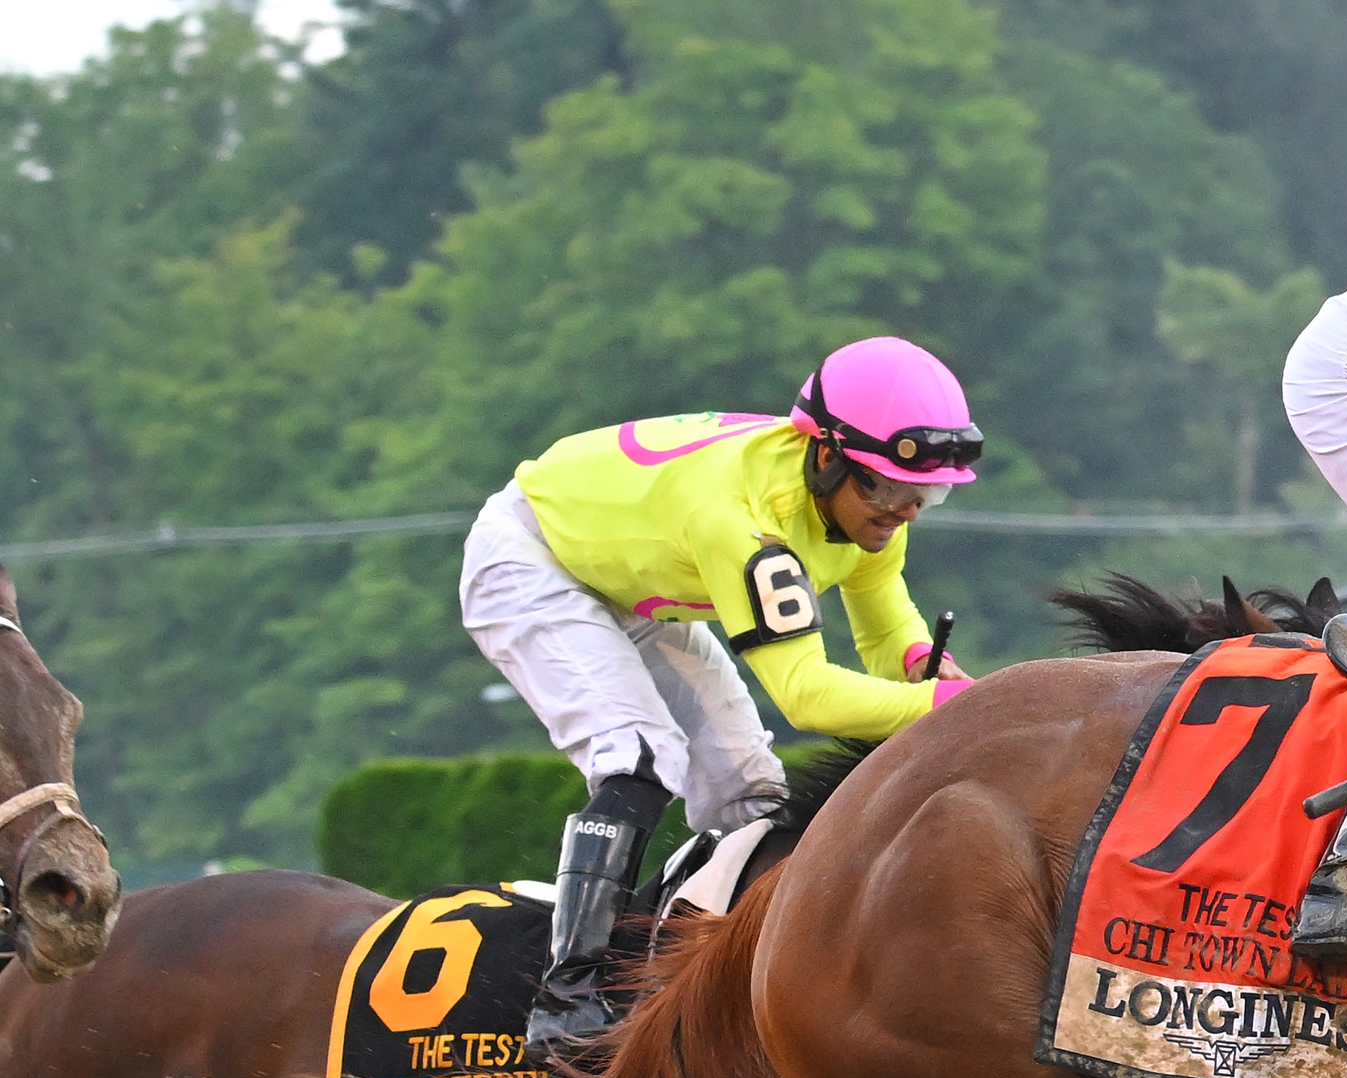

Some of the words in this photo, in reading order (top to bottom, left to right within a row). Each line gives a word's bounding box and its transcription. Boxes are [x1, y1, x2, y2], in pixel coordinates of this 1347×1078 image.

[753, 553, 816, 635] 6
[1130, 673, 1318, 872] 7
[574, 820, 618, 839] AGGB
[1179, 883, 1239, 927] THE
[369, 889, 512, 1032] 6
[1104, 917, 1176, 967] CHI
[1183, 932, 1281, 980] TOWN
[408, 1035, 455, 1070] THE
